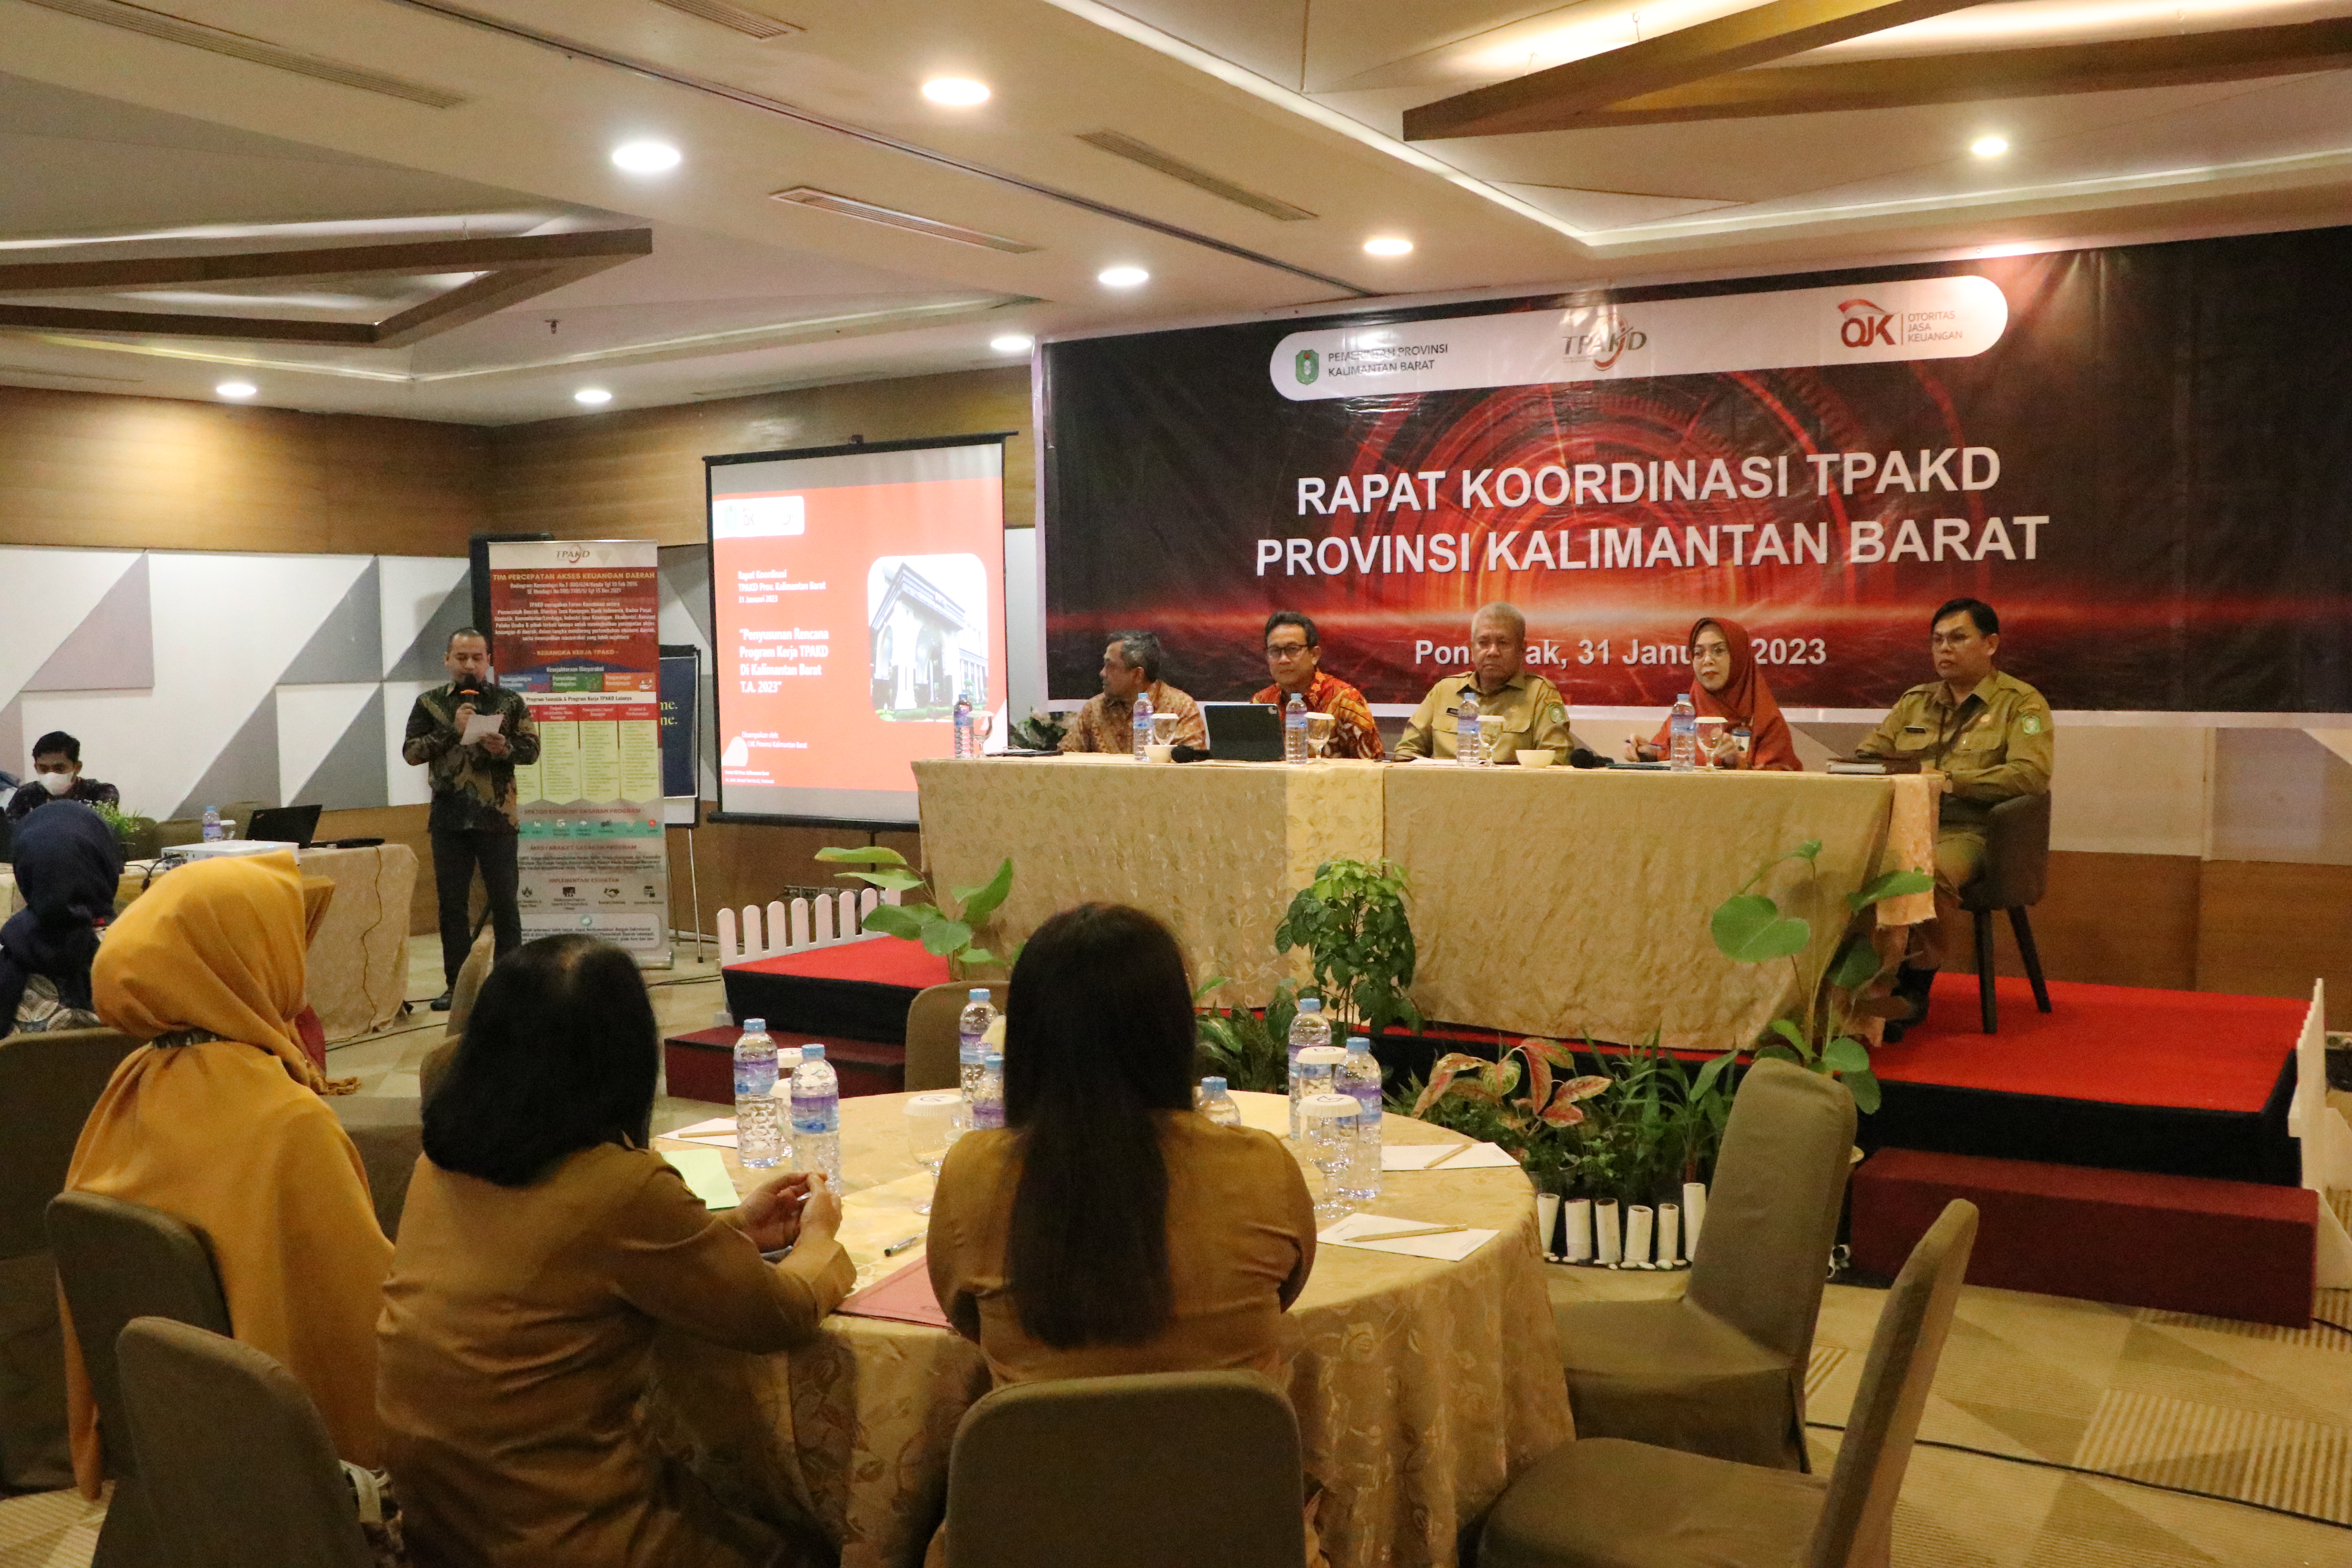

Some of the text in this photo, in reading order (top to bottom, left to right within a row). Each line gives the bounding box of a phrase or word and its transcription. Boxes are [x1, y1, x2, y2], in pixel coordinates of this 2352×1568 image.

[1908, 311, 1955, 321] OTORITAS
[1841, 314, 1896, 347] OJK
[1908, 323, 1931, 332] JASA
[1563, 327, 1647, 355] TPAKD
[1908, 331, 1963, 342] KEUANGAN
[1328, 344, 1448, 362] PEMERINTAH PROVINSI
[1328, 360, 1435, 376] KALIMANTAN BARAT
[1298, 446, 2000, 515] RAPAT KOORDINASI TPAKD
[1256, 515, 2049, 576] PROVINSI KALIMANTAN BARAT
[738, 570, 787, 581] Rapat Koordinasi
[738, 581, 826, 592] TPAKD Prov. Kalimantan Barat
[794, 628, 829, 639] Rencana
[740, 645, 828, 661] Program Kerja TPAKD
[1416, 638, 1827, 669] Ponak, 31 Janu 2023
[740, 663, 822, 675] Di Kalimantan Barat
[740, 681, 756, 693] T.A.
